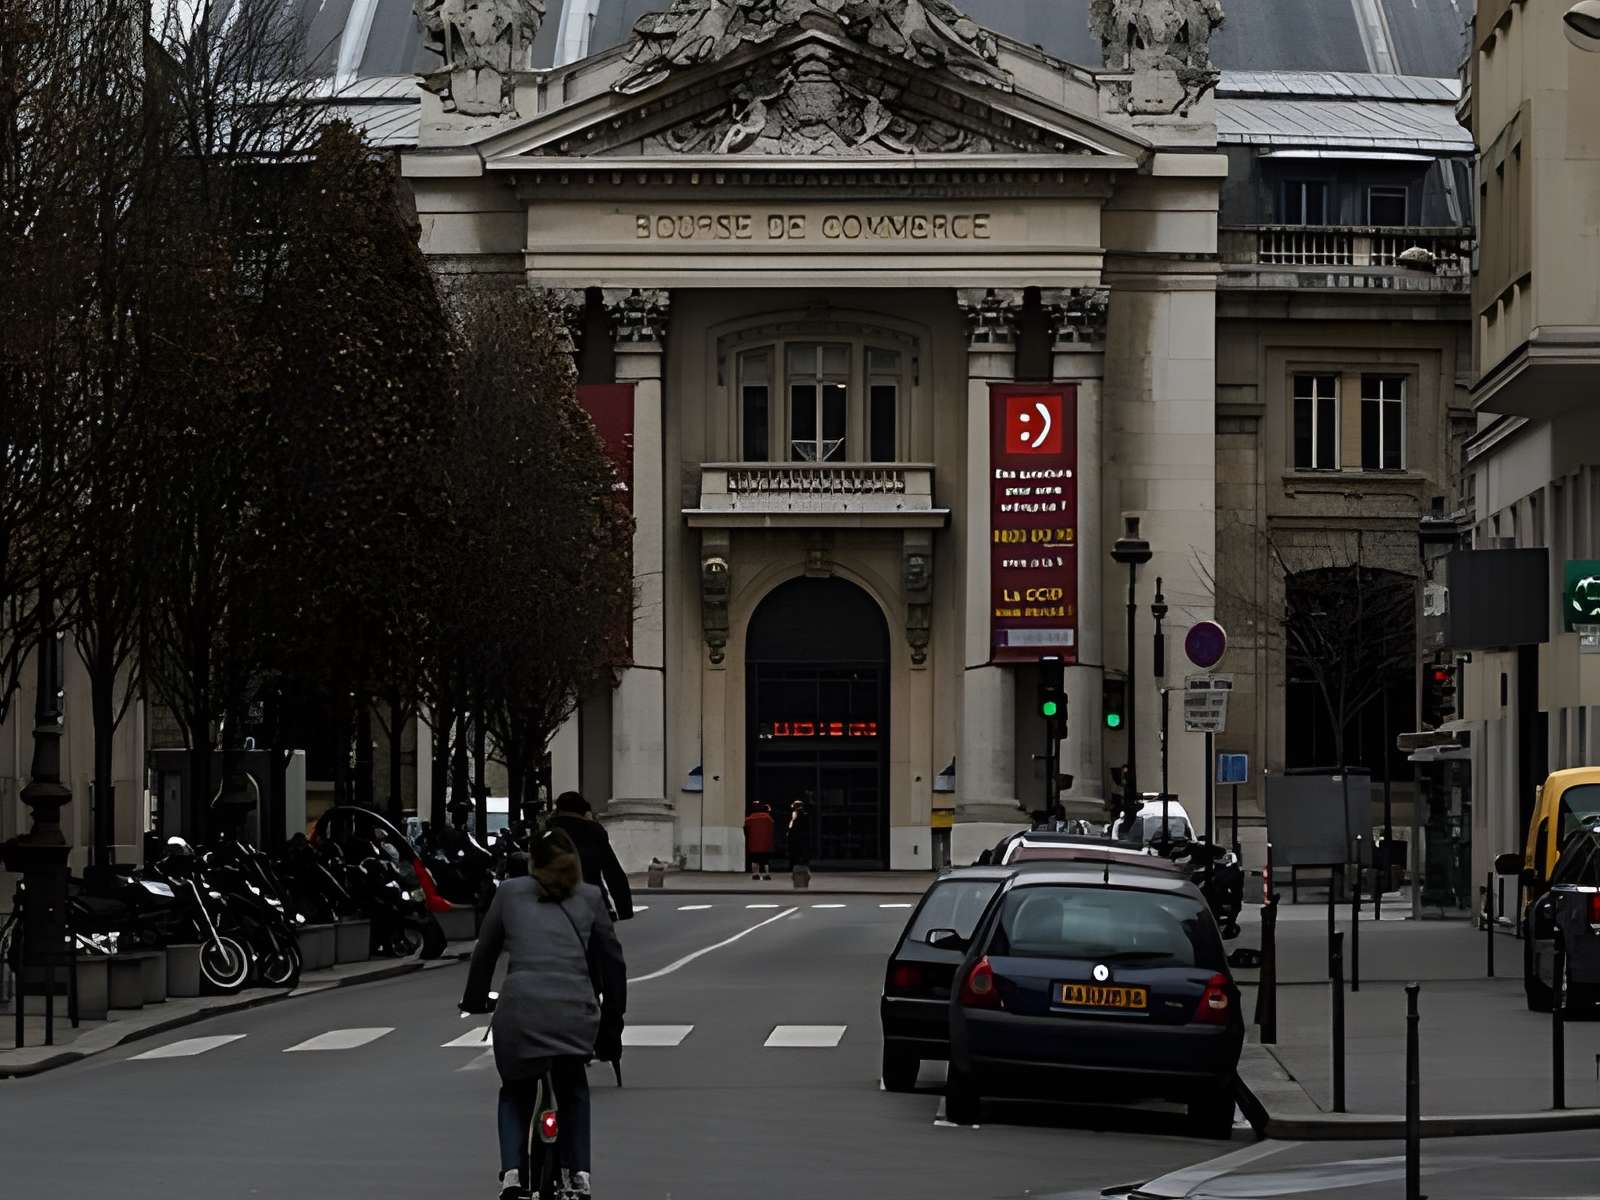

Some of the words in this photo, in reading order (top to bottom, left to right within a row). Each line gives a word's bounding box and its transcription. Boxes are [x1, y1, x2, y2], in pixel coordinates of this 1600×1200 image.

[636, 214, 752, 239] BOURSE
[767, 214, 806, 239] DE
[822, 213, 991, 239] COMMERCE
